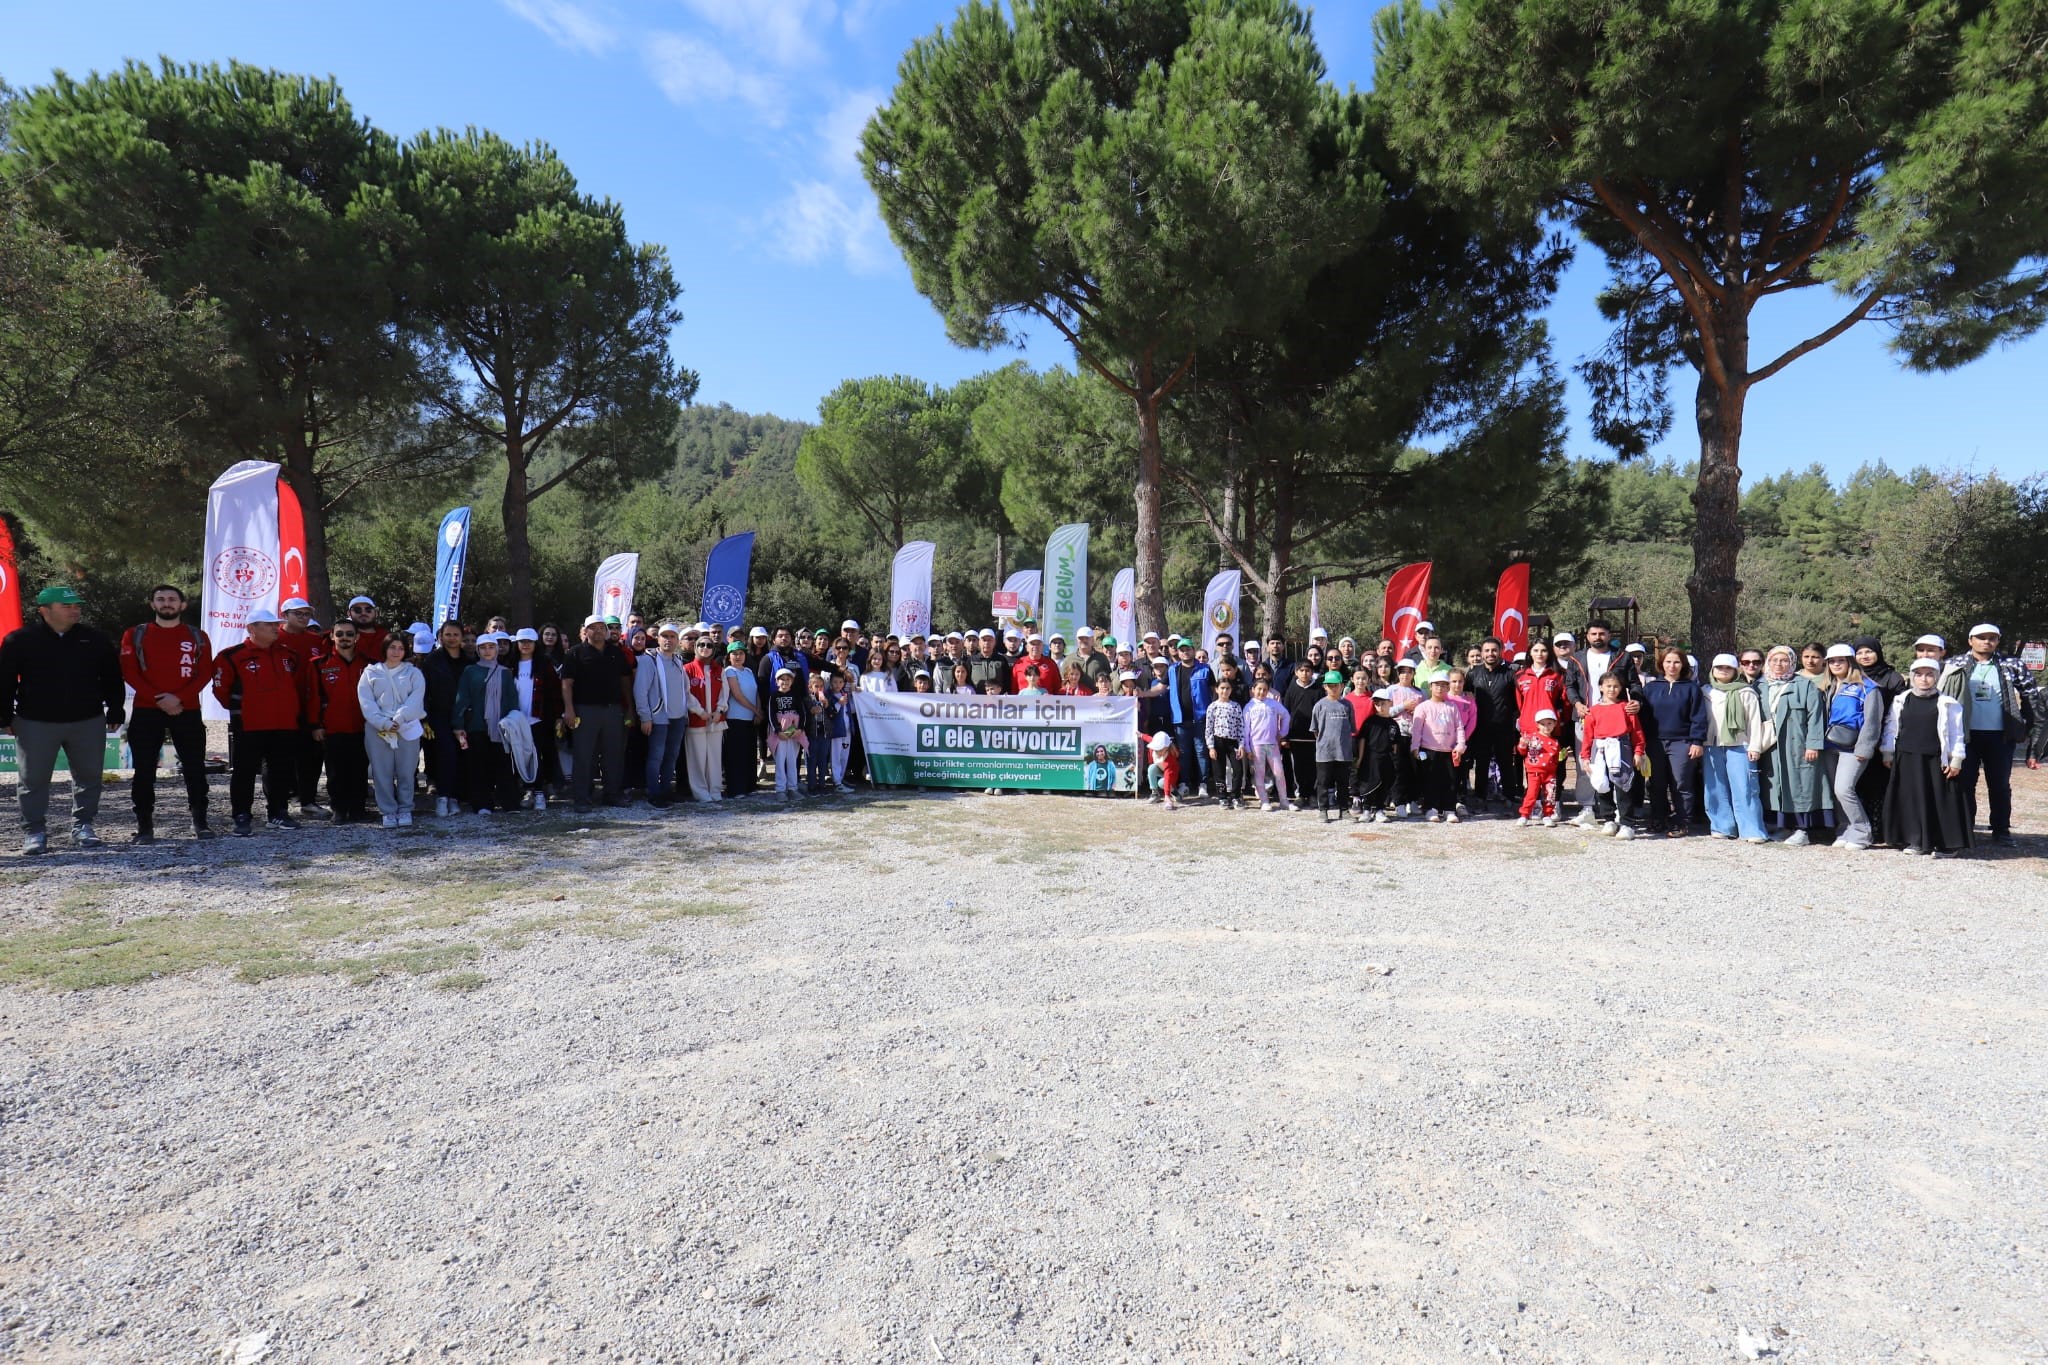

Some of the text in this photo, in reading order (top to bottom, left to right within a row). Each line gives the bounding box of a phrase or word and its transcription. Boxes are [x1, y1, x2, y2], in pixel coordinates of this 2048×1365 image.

[919, 700, 1076, 727] ormanlar için
[921, 725, 940, 748] el
[945, 726, 975, 749] ele
[980, 727, 1077, 753] veriyoruz!
[913, 760, 1081, 772] Hep birlikte ormanlarımızı temizleyerek,
[913, 771, 1042, 782] geleceğimize sahip çıkıyoruz!
